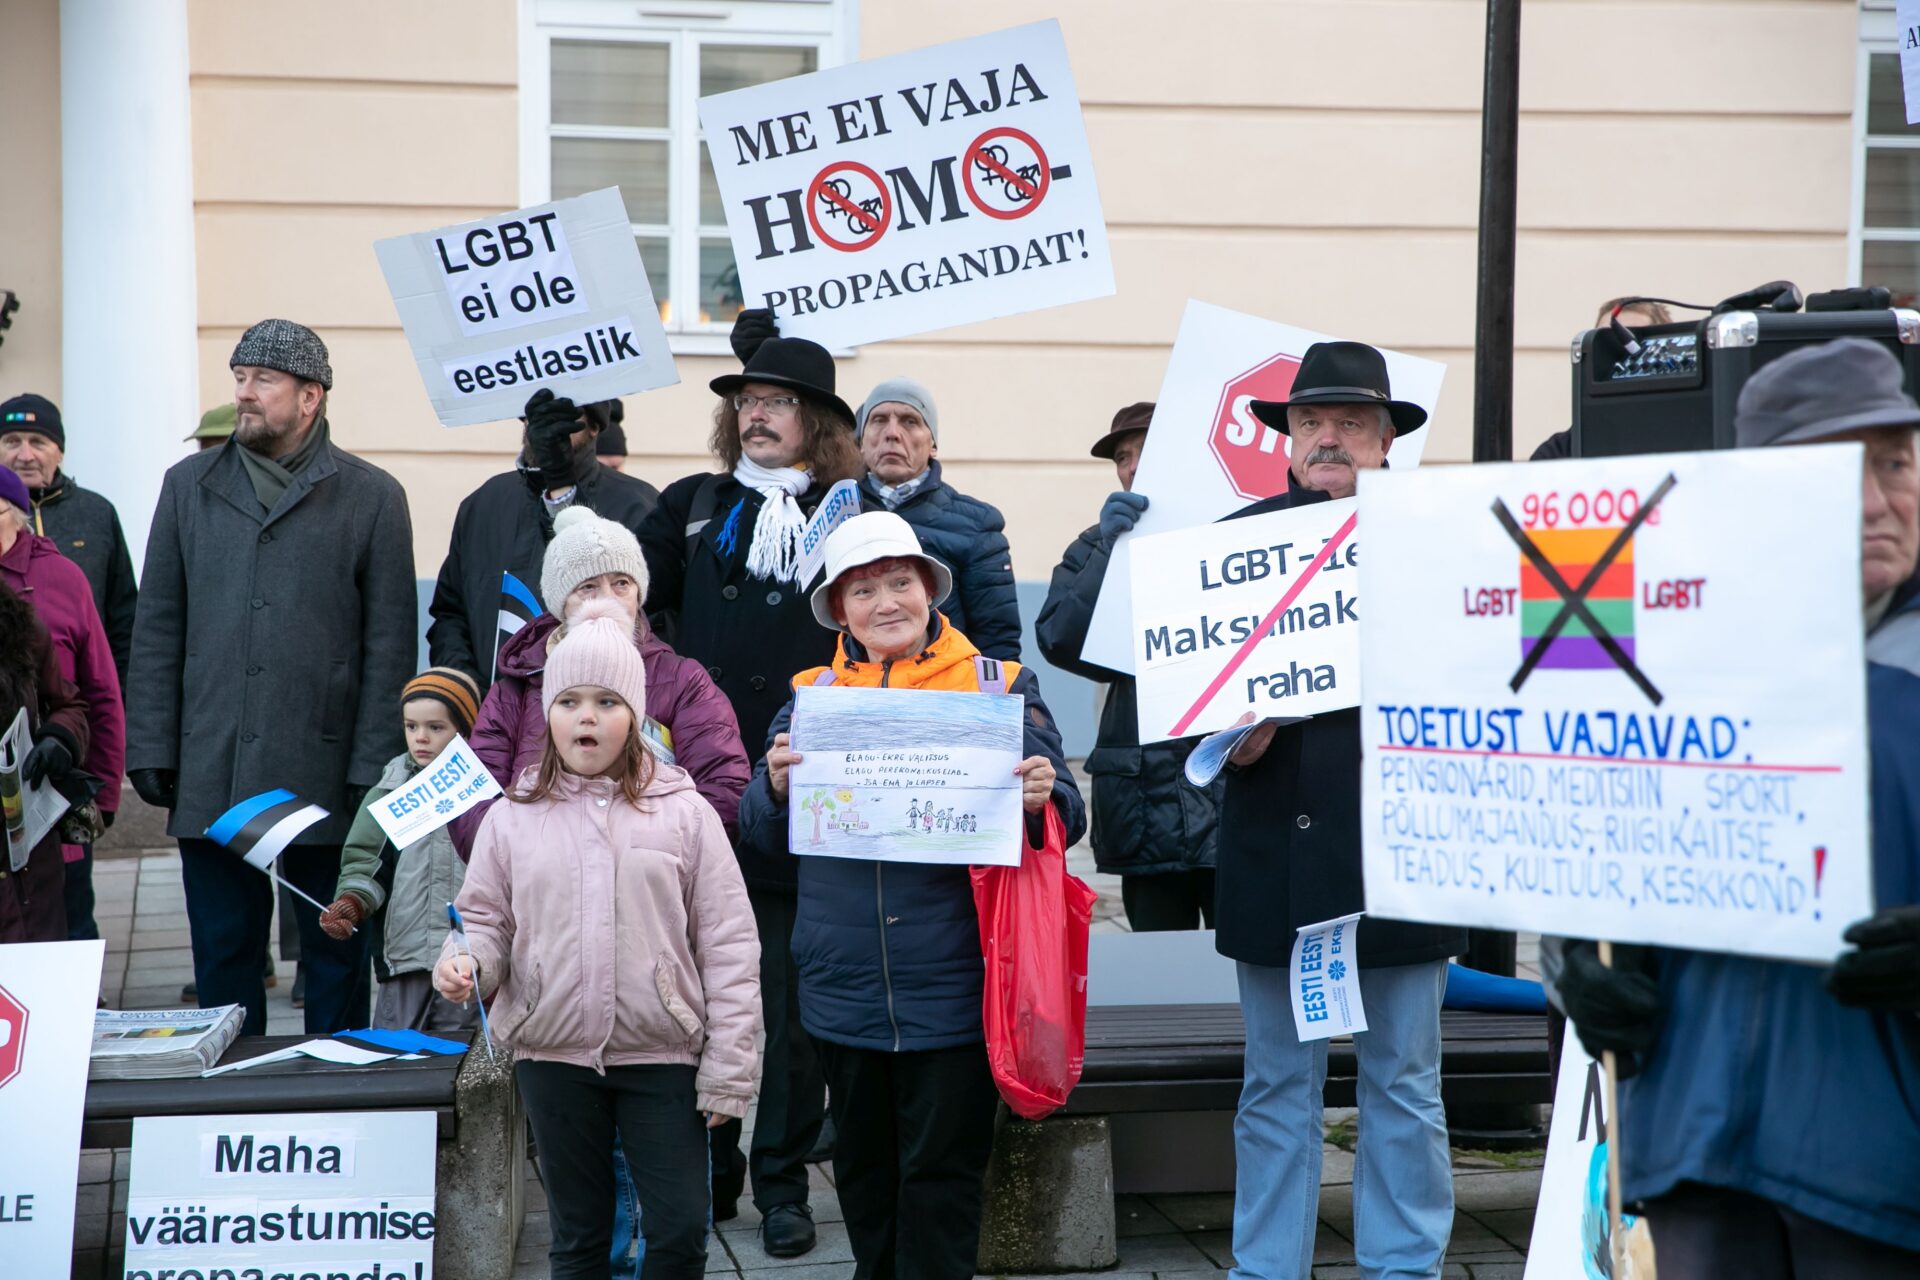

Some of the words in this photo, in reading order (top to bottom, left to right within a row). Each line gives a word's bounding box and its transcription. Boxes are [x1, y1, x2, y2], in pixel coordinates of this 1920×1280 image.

[728, 111, 817, 166] ME
[827, 94, 892, 145] EI
[897, 63, 1049, 127] VAJA
[435, 212, 556, 274] LGBT
[461, 282, 499, 323] ei
[510, 271, 576, 313] ole
[762, 229, 1089, 320] PROPAGANDAT!
[453, 326, 640, 393] eestlaslik
[803, 517, 826, 556] EESTI
[825, 488, 855, 525] EEST!
[1464, 587, 1517, 617] LGBT
[1643, 576, 1706, 610] LGBT
[1247, 661, 1337, 703] raha
[1378, 706, 1523, 754] TOETUST
[1545, 711, 1753, 763] VAJAVAD:
[387, 783, 434, 819] EESTI
[429, 752, 470, 794] EEST!
[457, 773, 488, 801] EKRE
[845, 767, 872, 775] ELAGU
[1387, 844, 1496, 897] TEADUS,
[1331, 922, 1346, 954] EKRE
[1301, 976, 1328, 1023] EESTI
[215, 1134, 342, 1174] Maha
[128, 1202, 437, 1245] väärastumise
